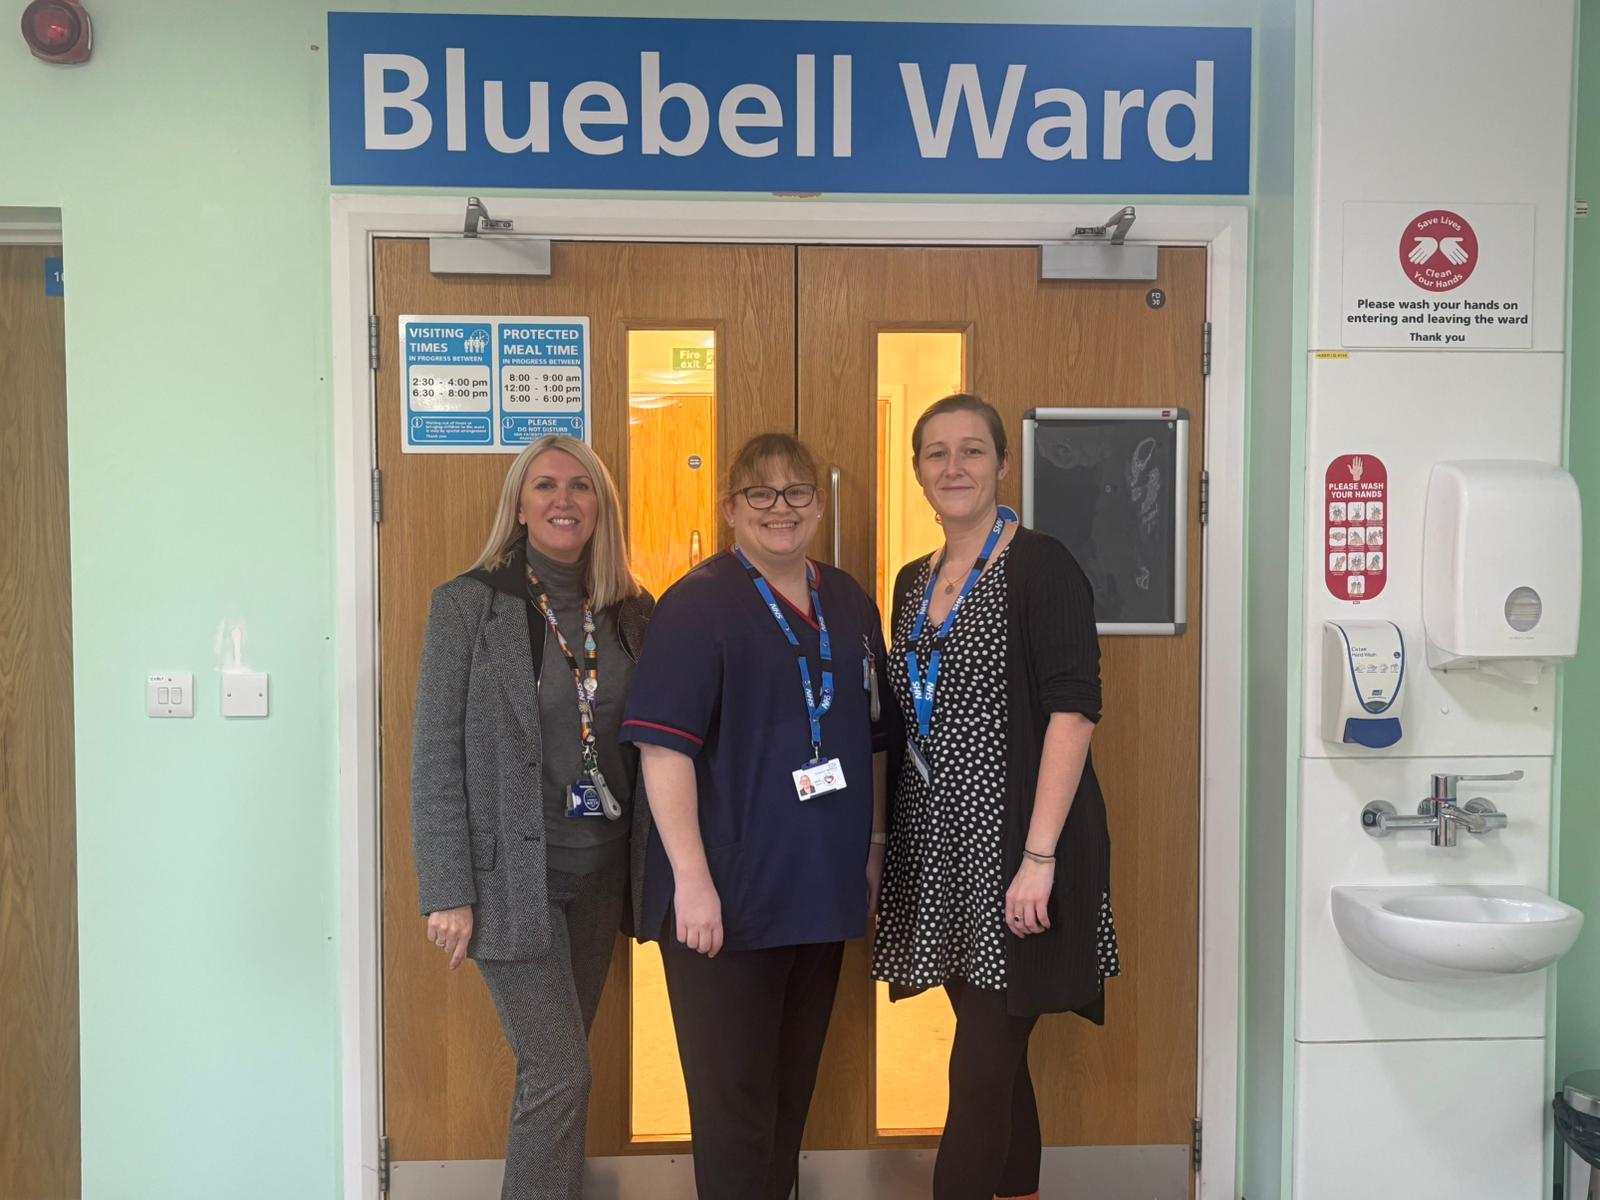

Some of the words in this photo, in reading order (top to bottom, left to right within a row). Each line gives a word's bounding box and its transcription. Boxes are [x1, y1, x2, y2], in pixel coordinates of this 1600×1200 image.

[362, 48, 852, 157] Bluebell
[898, 60, 1214, 162] Ward
[1417, 217, 1438, 230] Save
[1440, 216, 1462, 231] Lives
[1425, 268, 1452, 278] Clean
[1414, 271, 1434, 287] Your
[1436, 274, 1463, 288] Hands
[1357, 298, 1395, 309] Please
[1398, 299, 1430, 309] wash
[1433, 301, 1461, 311] your
[1464, 299, 1499, 310] hands
[1502, 302, 1518, 310] on
[1347, 313, 1398, 325] entering
[1401, 313, 1424, 323] and
[1427, 314, 1471, 326] leaving
[1474, 314, 1494, 324] the
[1497, 314, 1528, 324] ward
[409, 328, 464, 338] VISITING
[503, 329, 579, 340] PROTECTED
[1409, 332, 1442, 342] Thank
[1444, 334, 1465, 344] you
[409, 343, 448, 353] TIMES
[503, 344, 543, 355] MEAL
[545, 345, 578, 355] TIME
[680, 350, 700, 359] Fire
[681, 359, 700, 369] exit
[412, 378, 434, 386] 2:30
[447, 378, 470, 386] 4:00
[472, 380, 488, 388] pm
[542, 374, 563, 382] 9:00
[504, 384, 530, 392] 12:00
[543, 384, 564, 392] 1:00
[412, 389, 434, 397] 6:30
[447, 389, 470, 397] 8:00
[472, 390, 488, 399] pm
[543, 395, 564, 403] 6:00
[566, 396, 580, 404] pm
[1329, 482, 1359, 490] PLEASE
[1360, 482, 1384, 490] WASH
[1331, 490, 1353, 498] YOUR
[1354, 490, 1382, 498] HANDS
[769, 603, 784, 619] NHS
[911, 681, 922, 699] NHS
[925, 681, 935, 701] NHS
[805, 688, 815, 707] NHS
